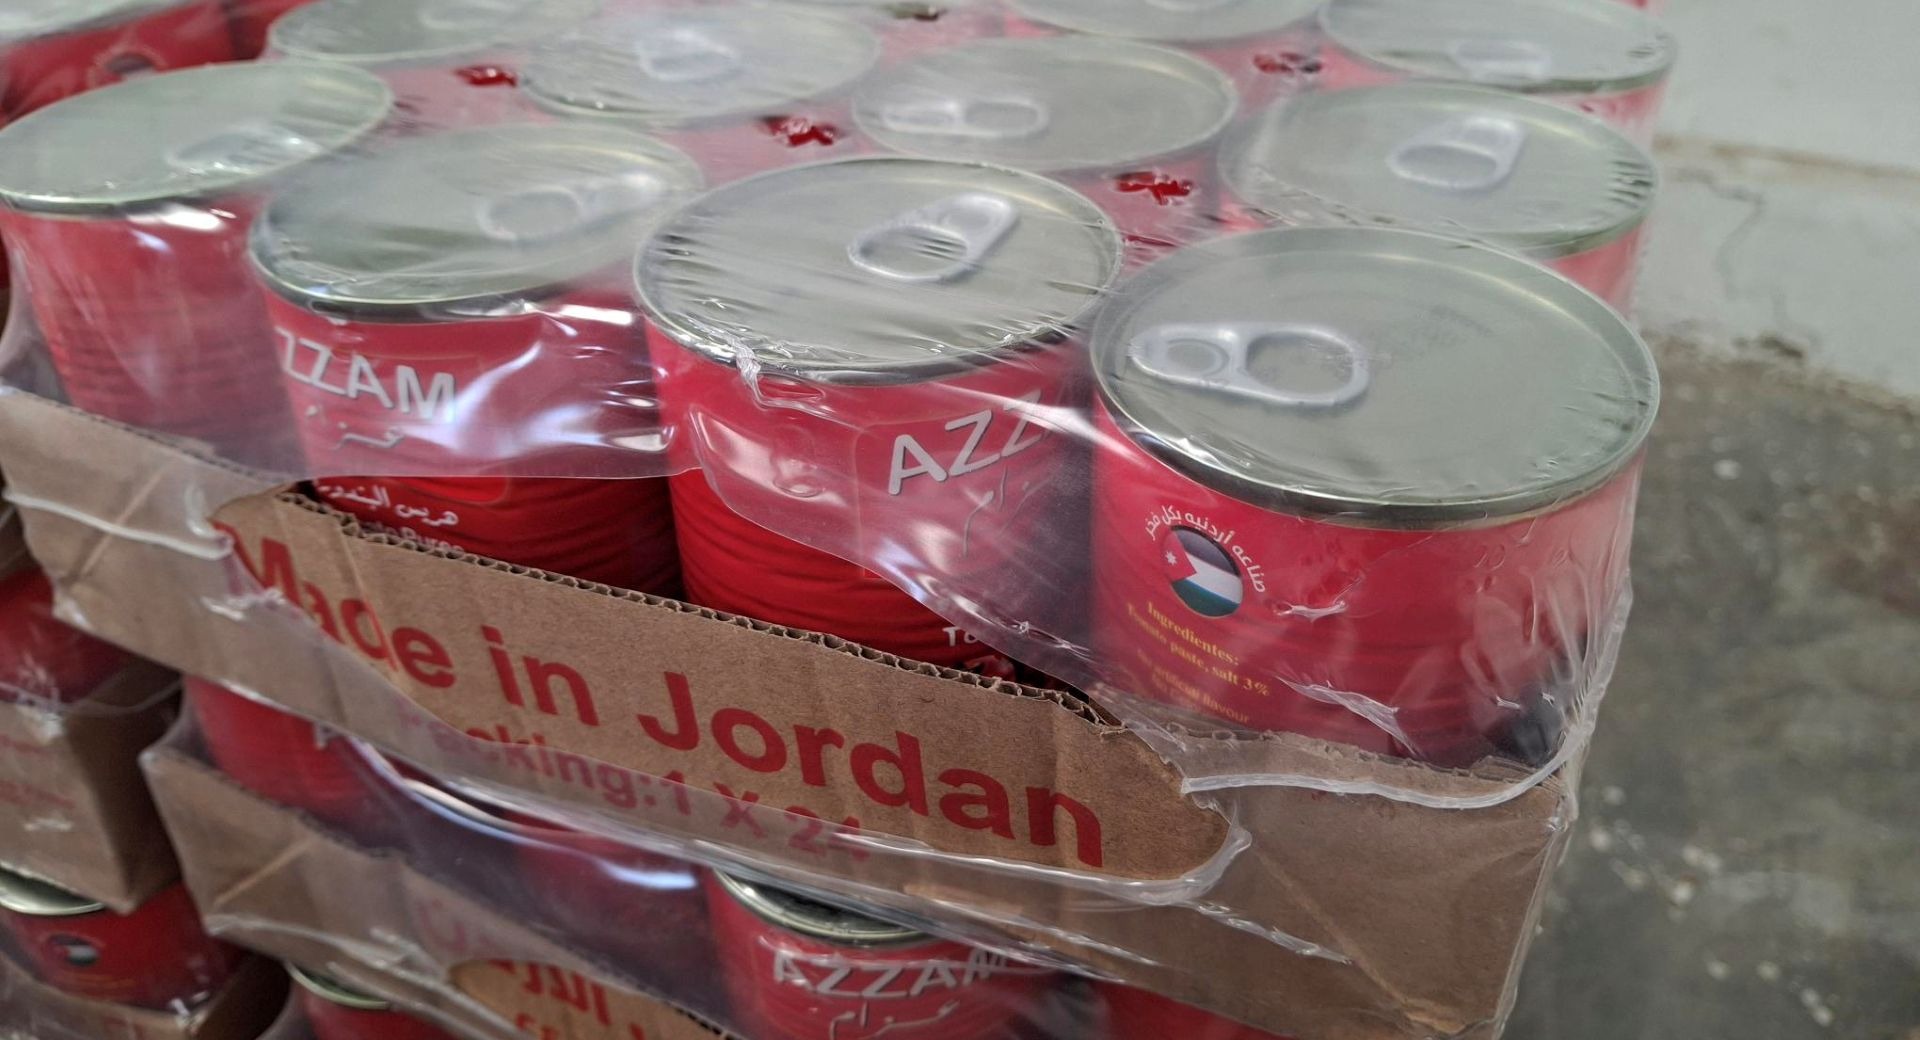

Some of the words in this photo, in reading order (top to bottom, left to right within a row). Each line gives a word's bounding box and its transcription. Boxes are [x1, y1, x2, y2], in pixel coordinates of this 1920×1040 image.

[1146, 600, 1240, 666] Ingredientes:
[1211, 665, 1239, 686] salt
[480, 623, 600, 727] in
[636, 671, 1104, 868] Jordan
